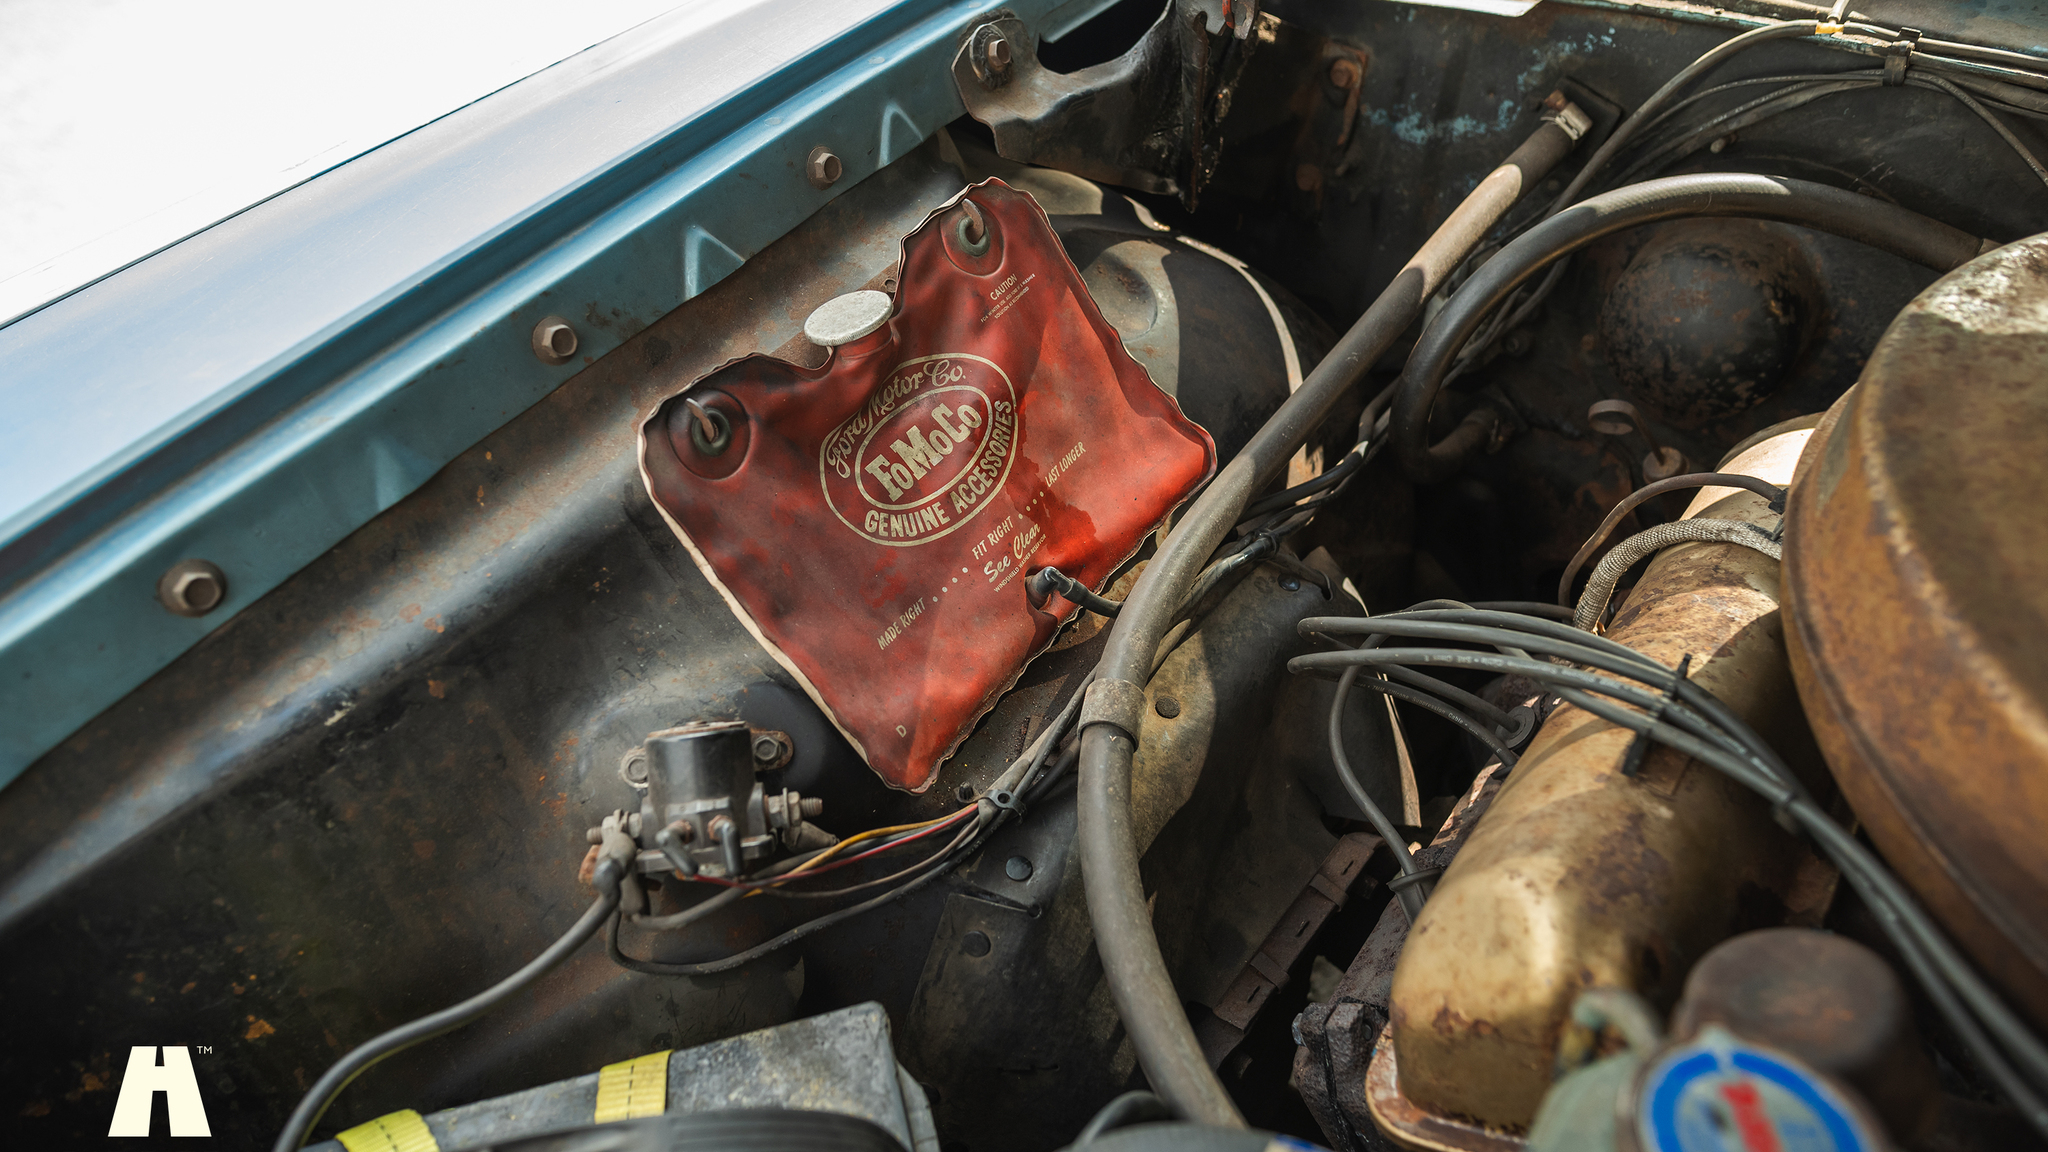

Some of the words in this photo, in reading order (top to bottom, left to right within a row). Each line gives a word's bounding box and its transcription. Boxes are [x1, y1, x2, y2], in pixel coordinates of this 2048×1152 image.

[990, 273, 1018, 300] CAUTION
[826, 410, 867, 478] Ford
[863, 371, 925, 435] Motor
[923, 359, 966, 387] Co.
[864, 402, 982, 502] FoMoCo
[864, 501, 951, 538] GENUINE
[949, 400, 1012, 514] ACCESSORIES
[877, 622, 902, 650] MADE
[899, 597, 926, 628] RIGHT
[972, 539, 988, 560] FIT
[987, 516, 1013, 546] RIGHT
[1045, 465, 1061, 488] LAST
[1059, 441, 1087, 472] LONGER
[983, 555, 1011, 583] See
[1013, 523, 1041, 560] Clear
[993, 566, 1020, 593] WINDSHIELD
[895, 724, 907, 738] D
